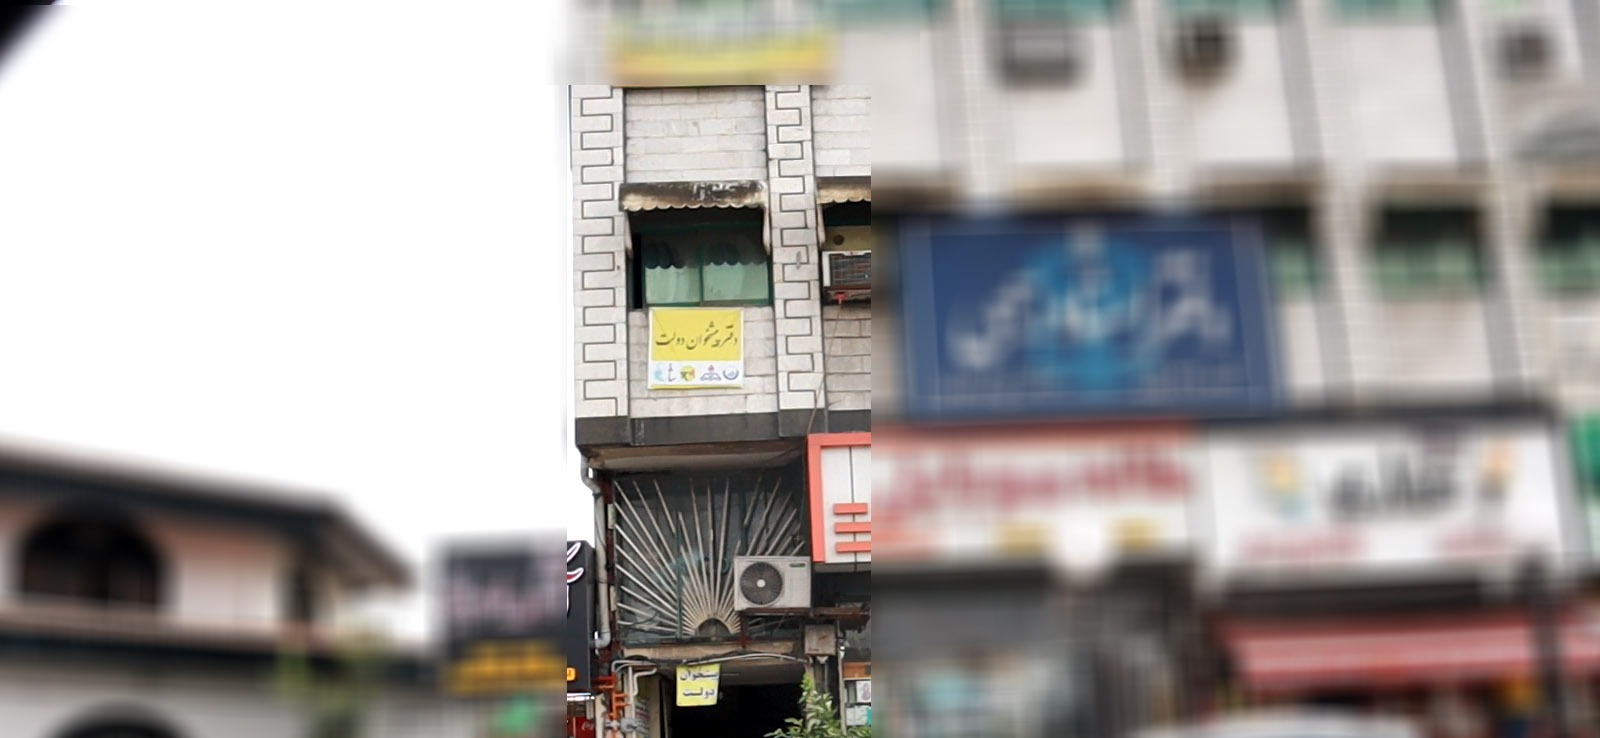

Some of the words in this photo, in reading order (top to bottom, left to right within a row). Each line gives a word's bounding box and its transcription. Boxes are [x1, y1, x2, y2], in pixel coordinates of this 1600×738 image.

[655, 331, 685, 346] دولت
[719, 324, 738, 348] دفتر
[682, 687, 715, 699] دولت
